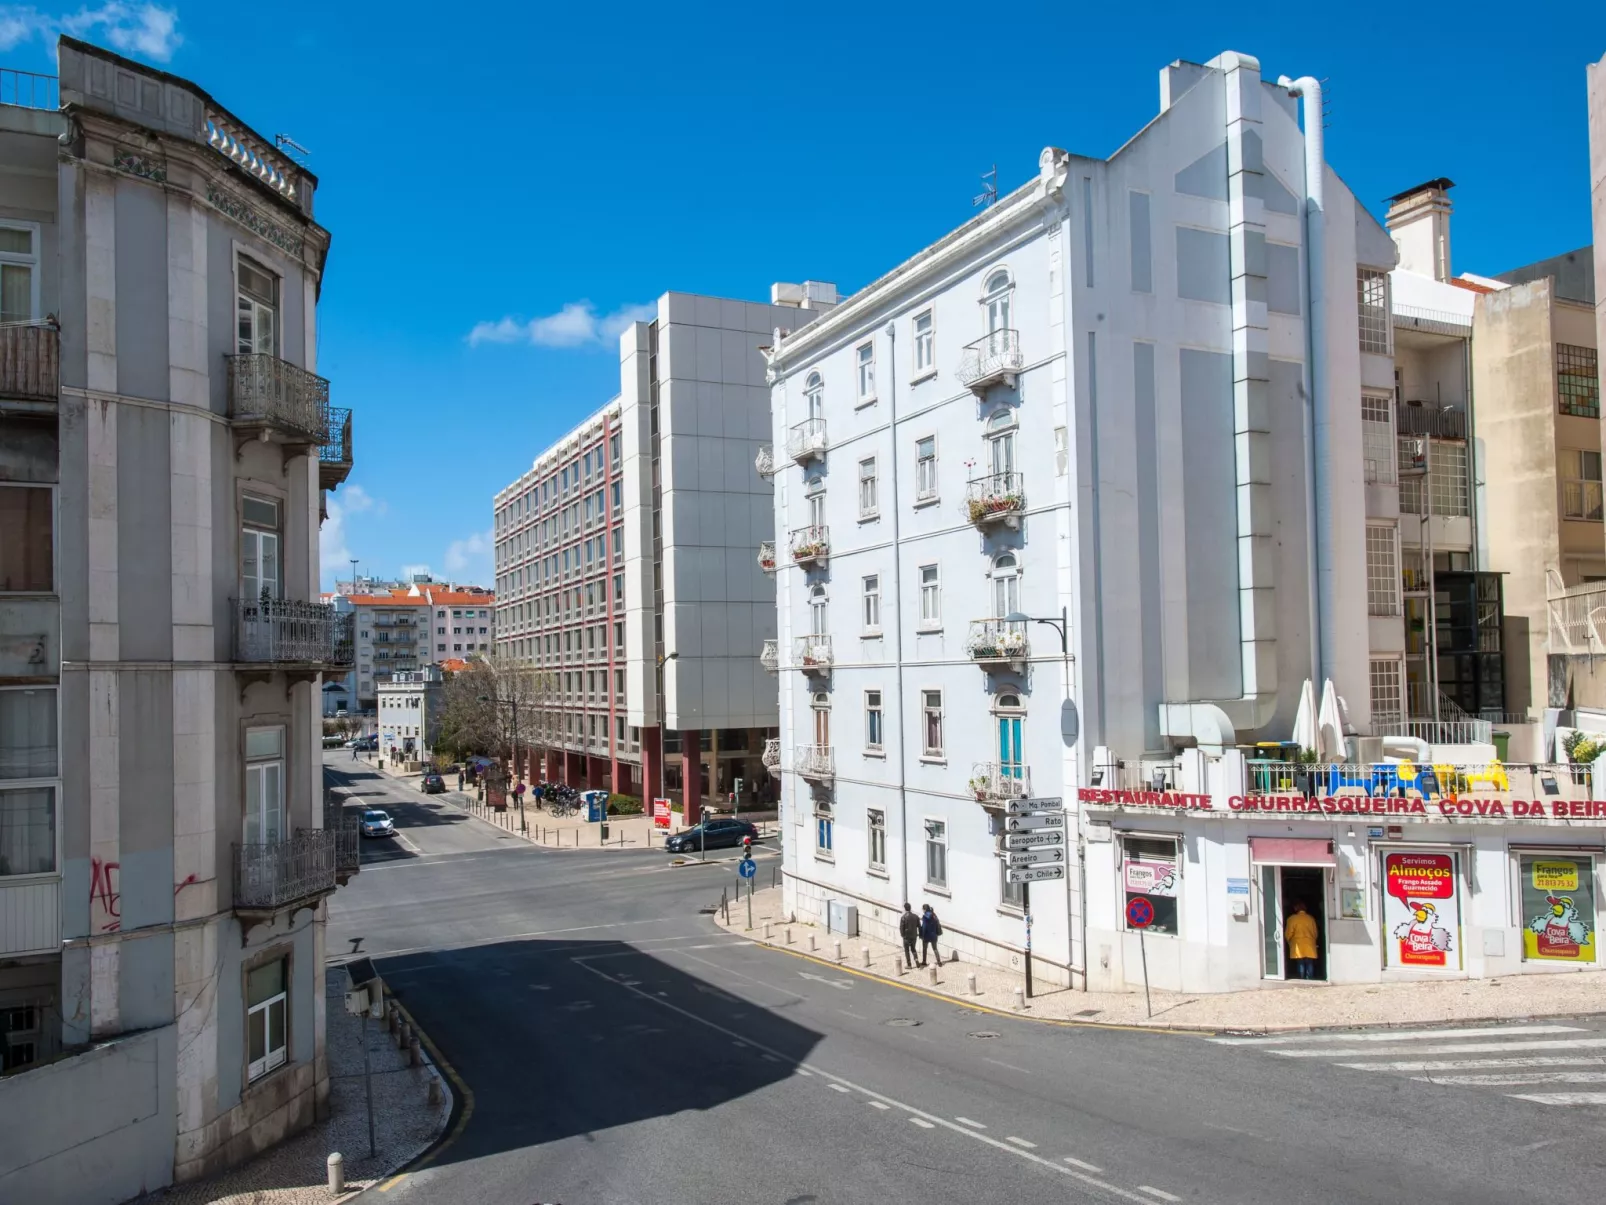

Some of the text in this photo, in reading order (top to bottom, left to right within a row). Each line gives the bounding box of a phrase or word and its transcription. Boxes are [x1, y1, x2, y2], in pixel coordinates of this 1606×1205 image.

[1041, 800, 1061, 808] Pombal
[1078, 788, 1212, 809] RESTAURANTE
[1228, 795, 1426, 813] CHURRASQUEIRA
[1439, 799, 1507, 815] COVA
[1512, 800, 1546, 816] DA
[1045, 817, 1061, 825] Rato
[1011, 835, 1044, 845] aeroporto
[1011, 855, 1038, 863] Areeiro
[1401, 857, 1436, 865] Servimos
[1036, 870, 1053, 878] Chile
[1129, 867, 1152, 878] Frangos
[1389, 864, 1450, 880] Almoços
[1536, 863, 1574, 878] Frangos
[1397, 878, 1420, 886] Frango
[1566, 880, 1574, 888] 32
[1402, 884, 1438, 892] Guarnecido
[1546, 927, 1566, 936] Cova
[1410, 933, 1429, 943] Cova
[1549, 935, 1570, 945] Beira
[1412, 942, 1433, 951] Beira
